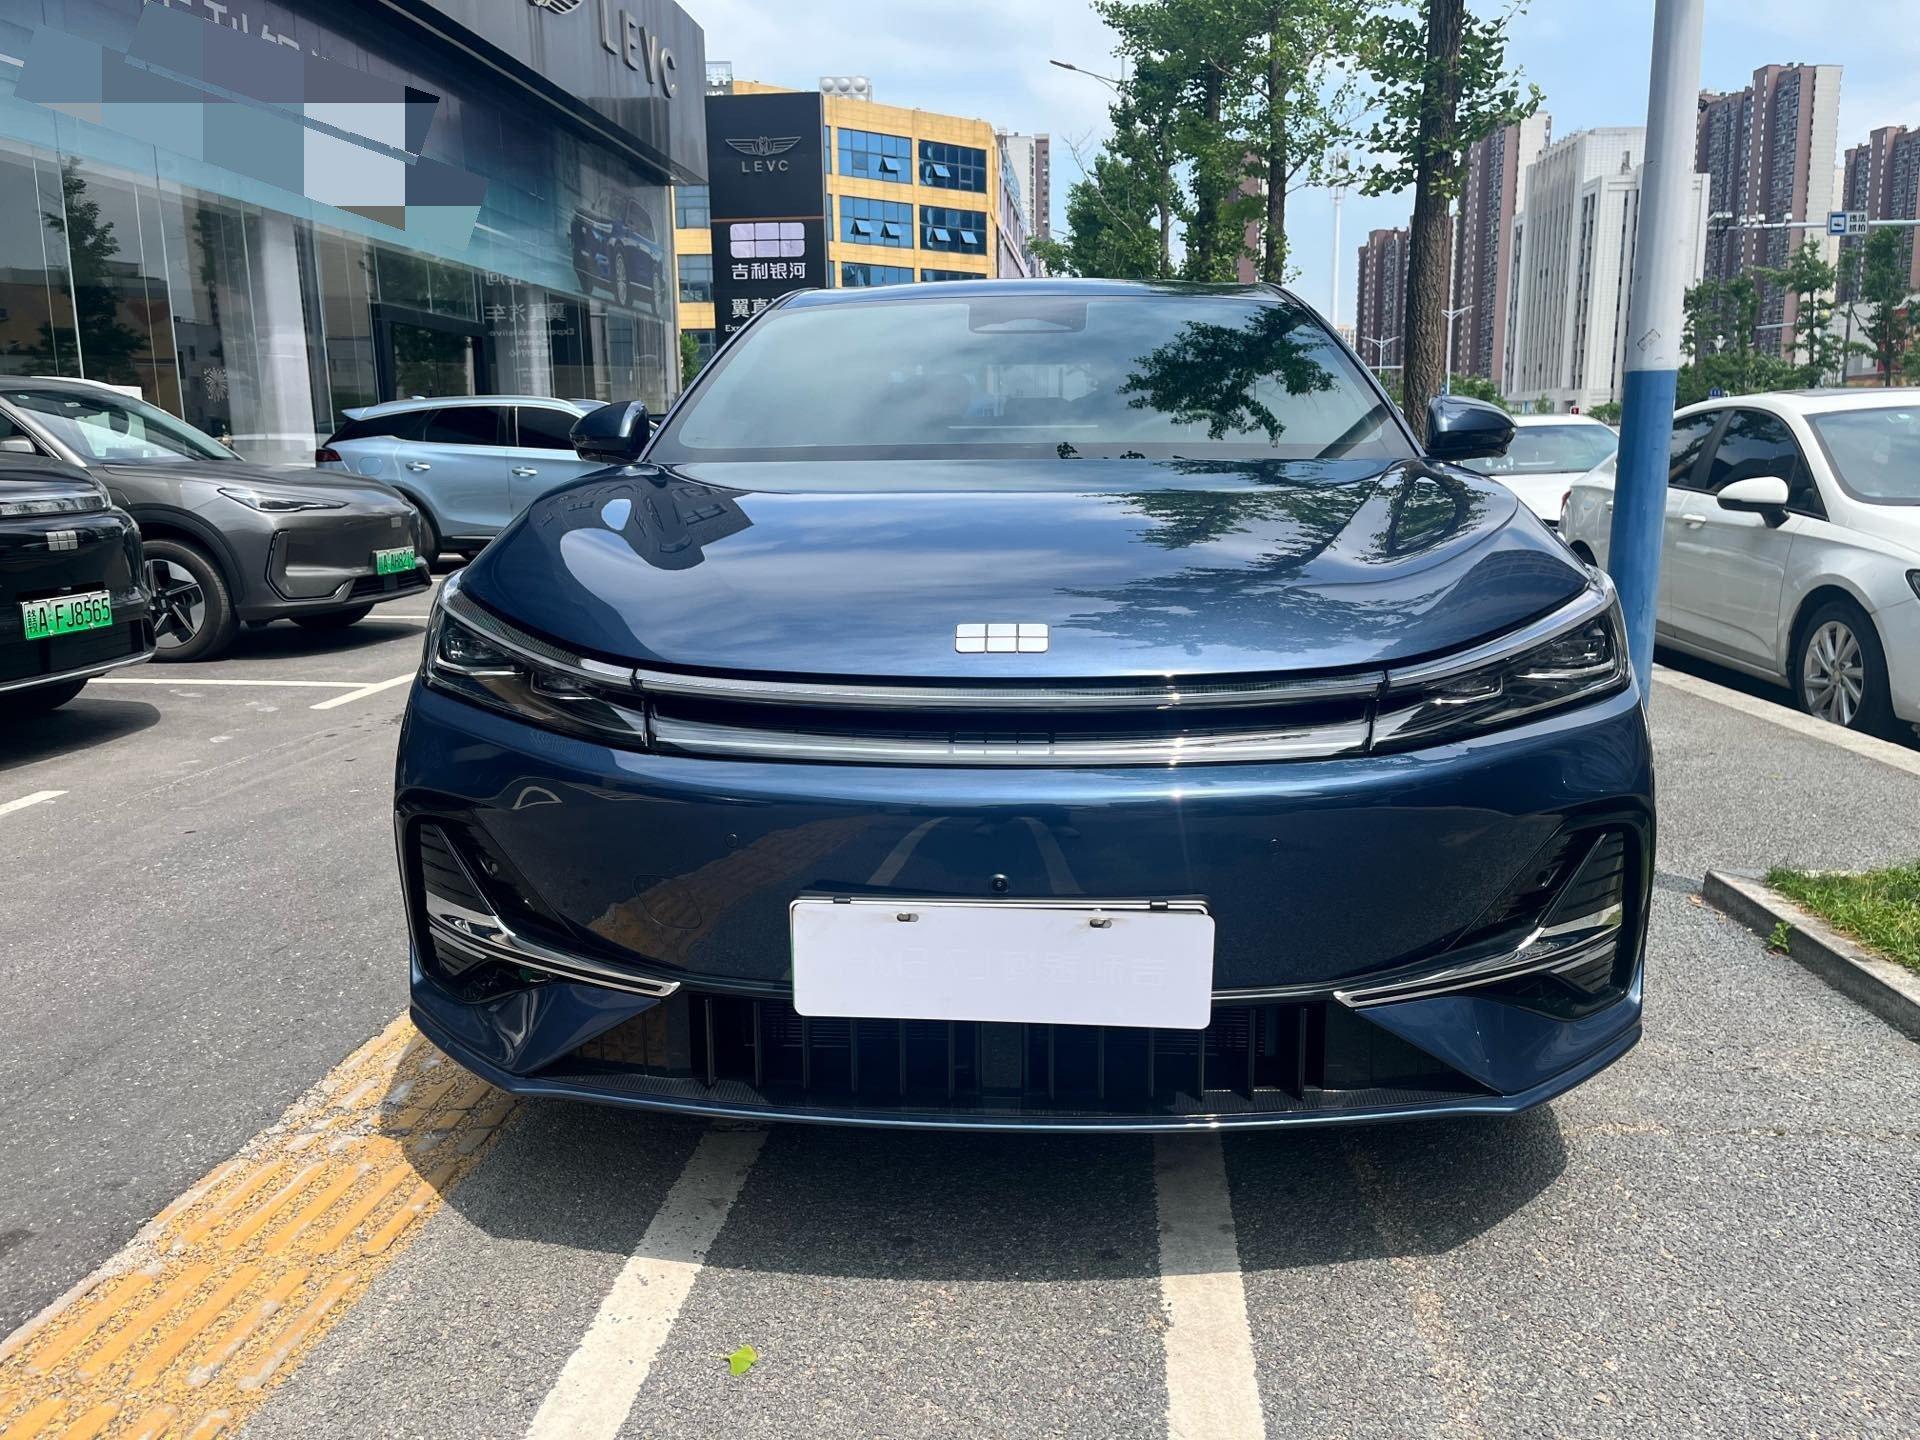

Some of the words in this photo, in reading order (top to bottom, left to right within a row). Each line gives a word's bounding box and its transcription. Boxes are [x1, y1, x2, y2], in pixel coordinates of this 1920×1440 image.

[598, 0, 677, 99] LEVC
[741, 160, 789, 173] LEVC
[731, 262, 806, 280] 吉利银河
[731, 298, 775, 318] 翼真
